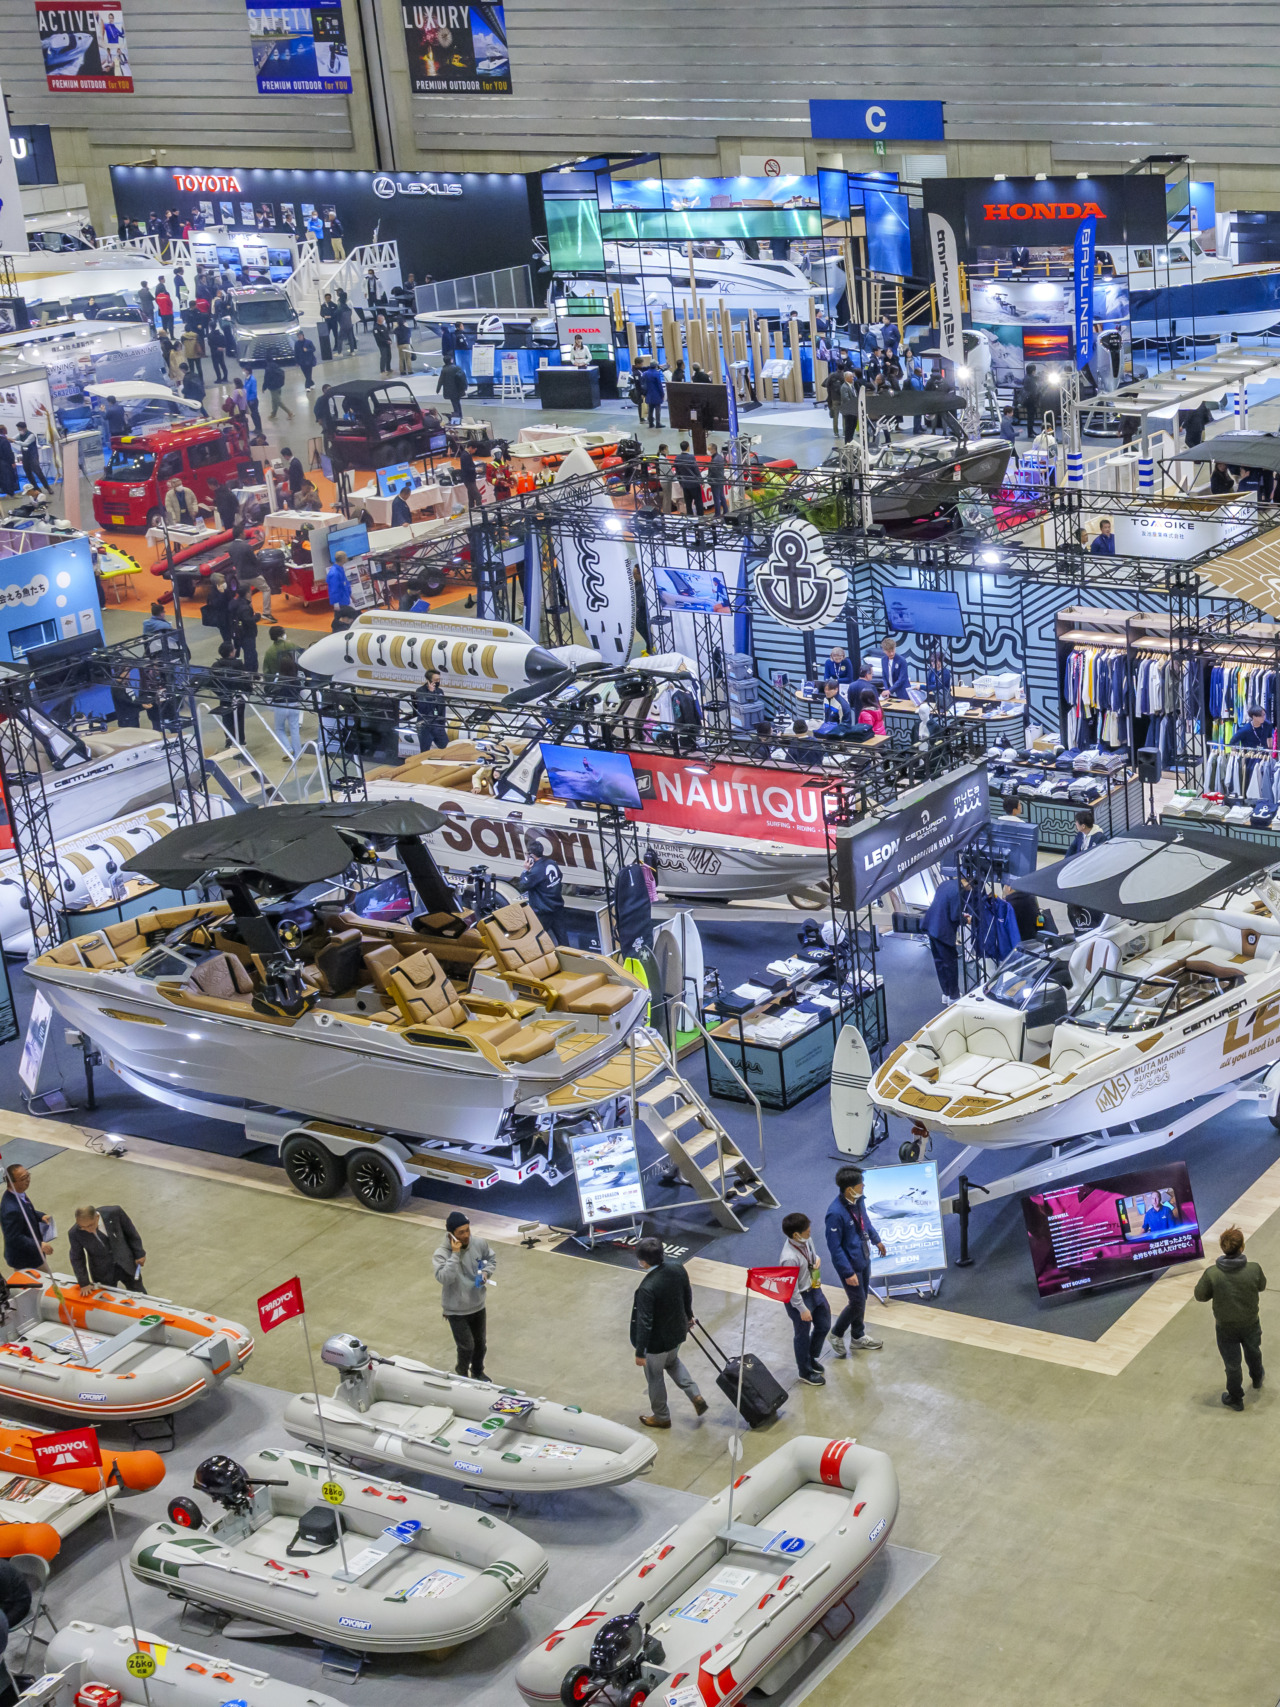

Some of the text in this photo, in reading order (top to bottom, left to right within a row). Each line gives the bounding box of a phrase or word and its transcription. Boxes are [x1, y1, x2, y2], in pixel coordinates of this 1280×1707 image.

[39, 10, 96, 32] ACTIVE
[247, 8, 312, 32] SAFETY
[402, 5, 470, 30] LUXURY
[52, 79, 130, 90] PREMIUM OUTDOOR for YOU
[261, 80, 348, 91] PREMIUM OUTDOOR for YOU
[416, 80, 508, 91] PREMIUM OUTDOOR for YOU
[865, 105, 887, 133] C
[172, 174, 242, 193] TOYOTA
[396, 182, 463, 196] LEXUS
[983, 202, 1107, 221] HONDA
[1080, 228, 1091, 355] BAYLINER
[1131, 518, 1195, 530] TOMOIKE
[766, 820, 791, 829] SURFING
[796, 824, 816, 833] RIDING
[437, 800, 597, 872] Safari
[939, 834, 954, 848] BOAT
[653, 843, 684, 853] MARINE
[864, 838, 901, 871] LEON
[1183, 998, 1247, 1036] CENTURION
[1133, 1047, 1186, 1076] MUTA MARINE
[1220, 1057, 1231, 1069] all
[1232, 1052, 1247, 1067] you
[1248, 1043, 1266, 1059] need
[1268, 1039, 1275, 1050] is
[1134, 1064, 1168, 1084] SURFING
[1149, 1234, 1193, 1250] 先ほど言ったような
[895, 1254, 920, 1264] LEON
[80, 1393, 106, 1401] JOYCRAFT
[455, 1460, 483, 1474] JOYCRAFT
[339, 1617, 372, 1630] JOYCRAFT
